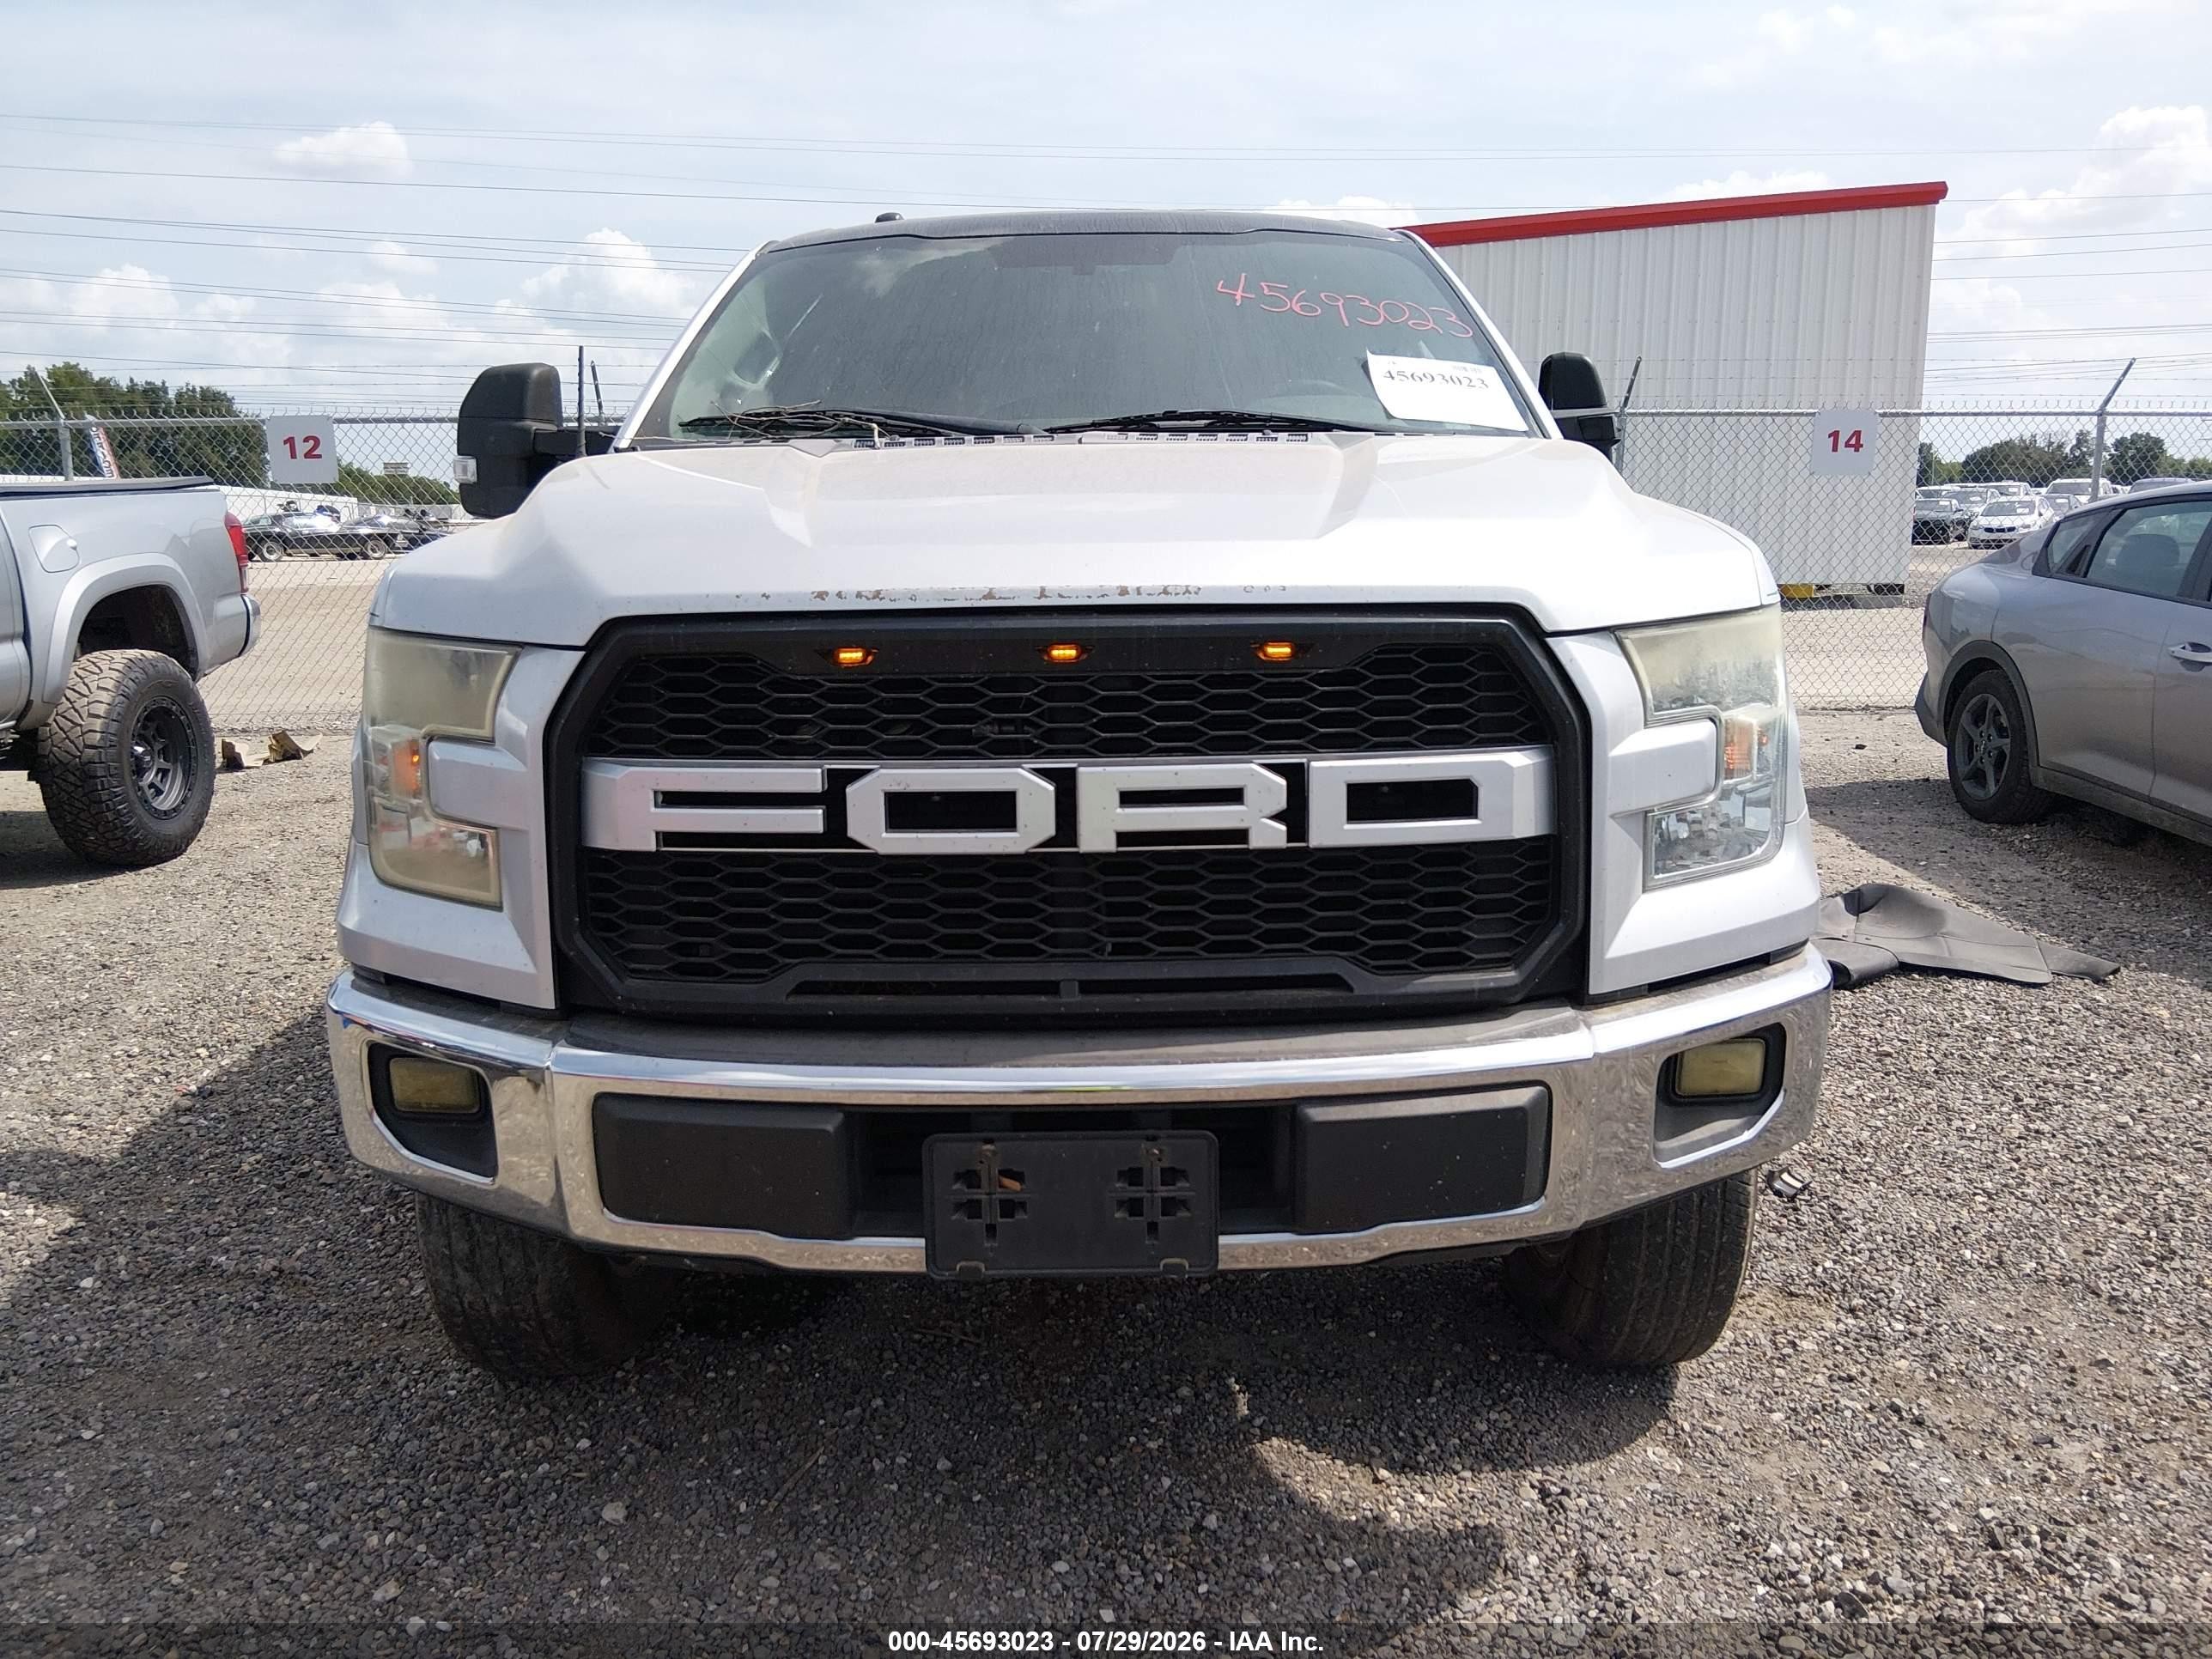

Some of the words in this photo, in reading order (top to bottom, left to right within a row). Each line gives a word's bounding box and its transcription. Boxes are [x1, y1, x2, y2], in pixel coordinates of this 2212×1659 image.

[1216, 273, 1474, 337] 45693023
[1382, 369, 1489, 389] 45693023
[283, 434, 323, 459] 12
[1827, 429, 1864, 453] 14
[582, 745, 1555, 854] FORD
